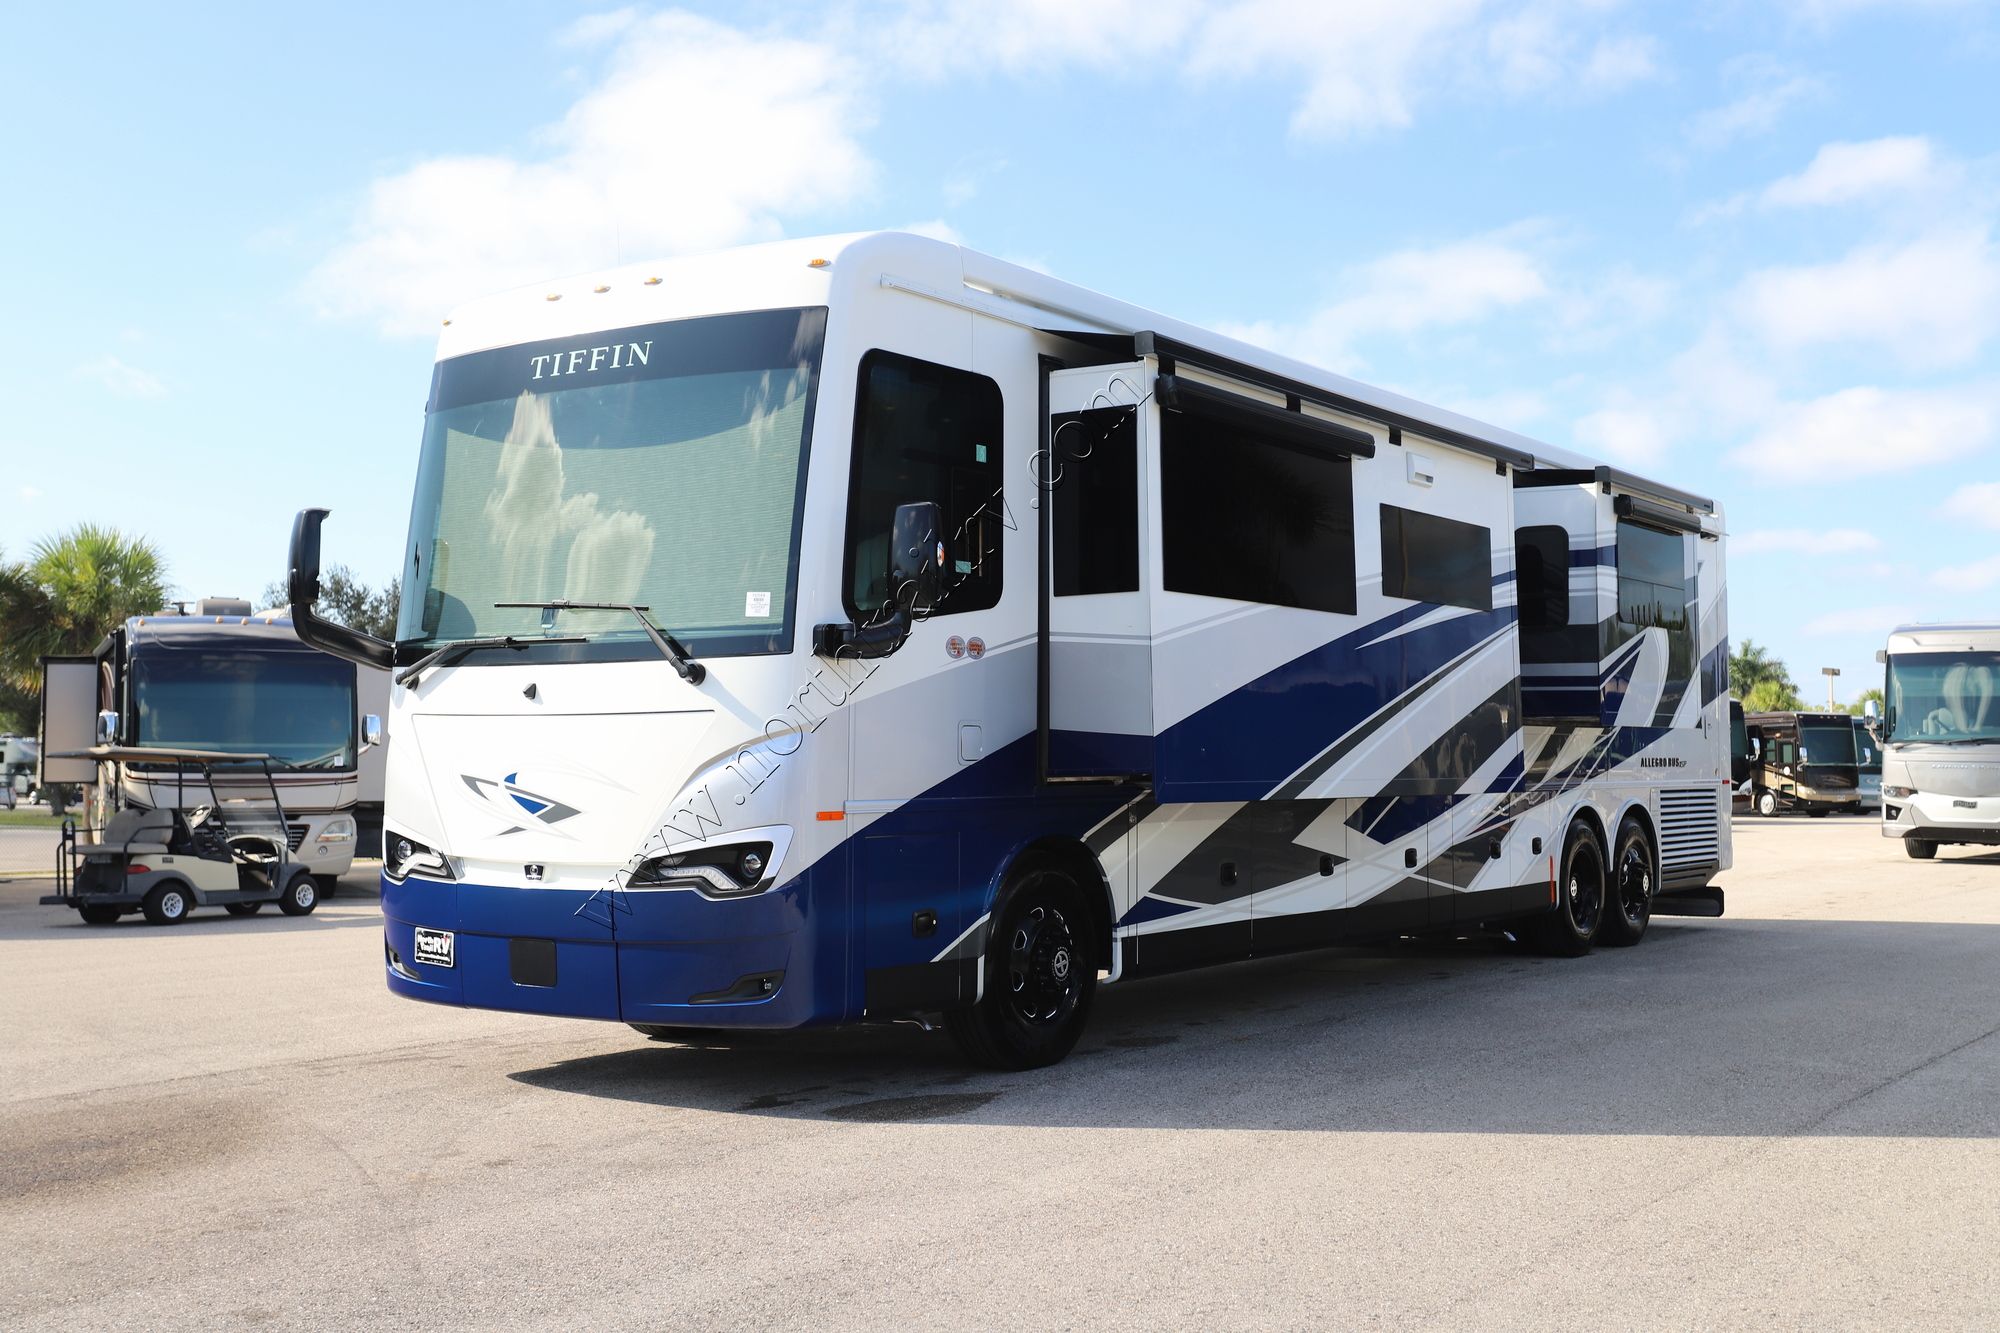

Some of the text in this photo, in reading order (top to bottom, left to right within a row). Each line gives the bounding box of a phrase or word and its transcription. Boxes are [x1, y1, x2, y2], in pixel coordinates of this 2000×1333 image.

[530, 340, 653, 380] TIFFIN
[1640, 757, 1667, 768] ALLEGRO
[1668, 757, 1679, 767] BUS
[433, 936, 450, 955] RV
